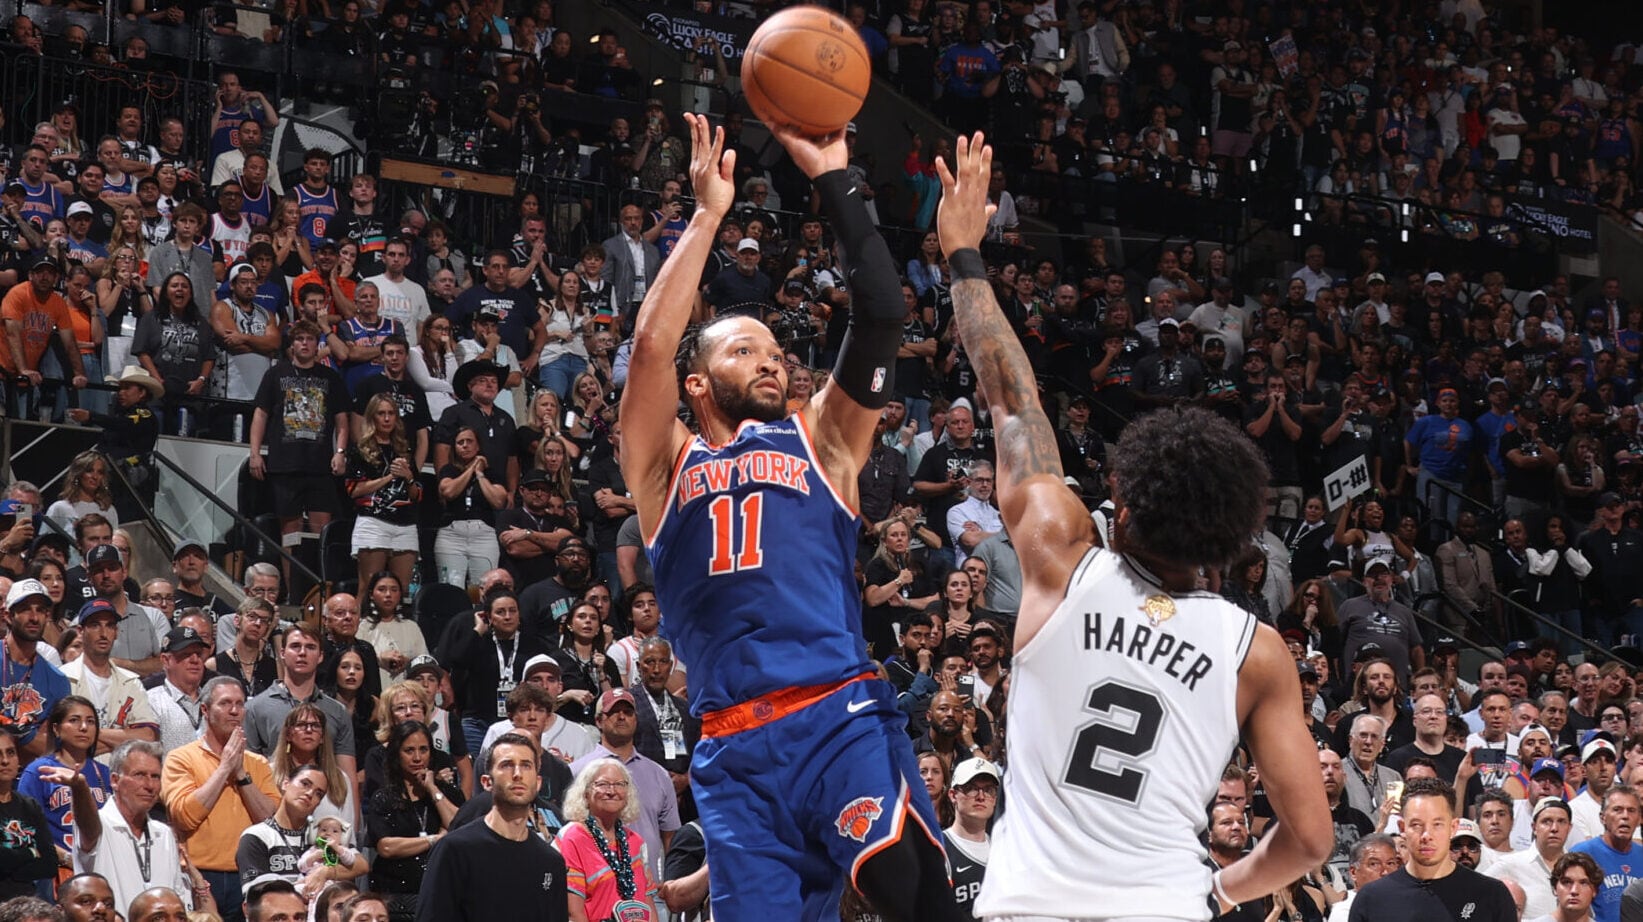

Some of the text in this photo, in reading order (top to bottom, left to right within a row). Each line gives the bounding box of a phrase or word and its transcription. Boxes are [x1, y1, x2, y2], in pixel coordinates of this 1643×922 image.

[672, 23, 734, 44] LUCKY EAGLE
[313, 217, 326, 237] 8
[959, 371, 970, 386] 5
[678, 450, 810, 514] NEW YORK
[708, 492, 763, 576] 11
[1084, 612, 1213, 692] HARPER
[1058, 676, 1170, 810] 2
[50, 785, 73, 812] NE
[1603, 873, 1625, 889] NEW
